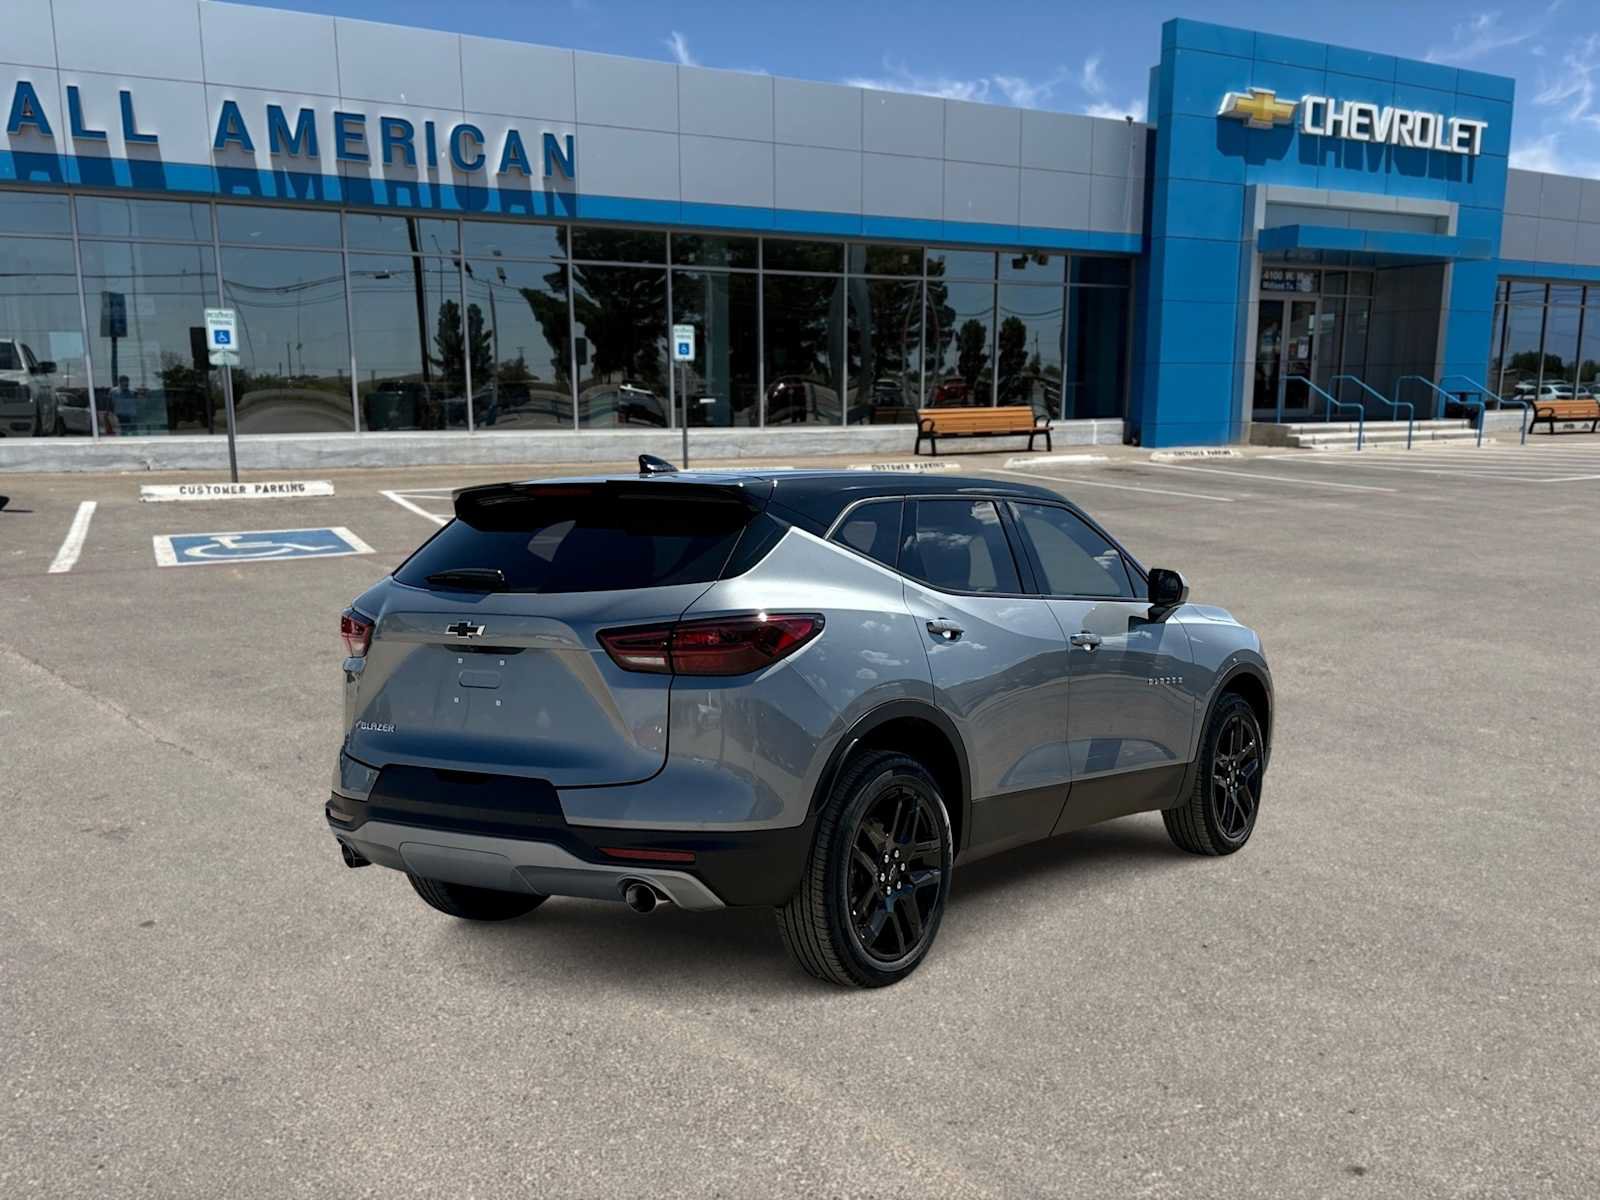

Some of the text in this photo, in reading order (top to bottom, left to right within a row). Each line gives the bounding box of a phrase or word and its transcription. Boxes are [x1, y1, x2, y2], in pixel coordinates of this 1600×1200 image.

[6, 80, 576, 179] ALL AMERICAN
[1301, 93, 1488, 155] CHEVROLET
[179, 483, 306, 495] CUSTOMER PARKING
